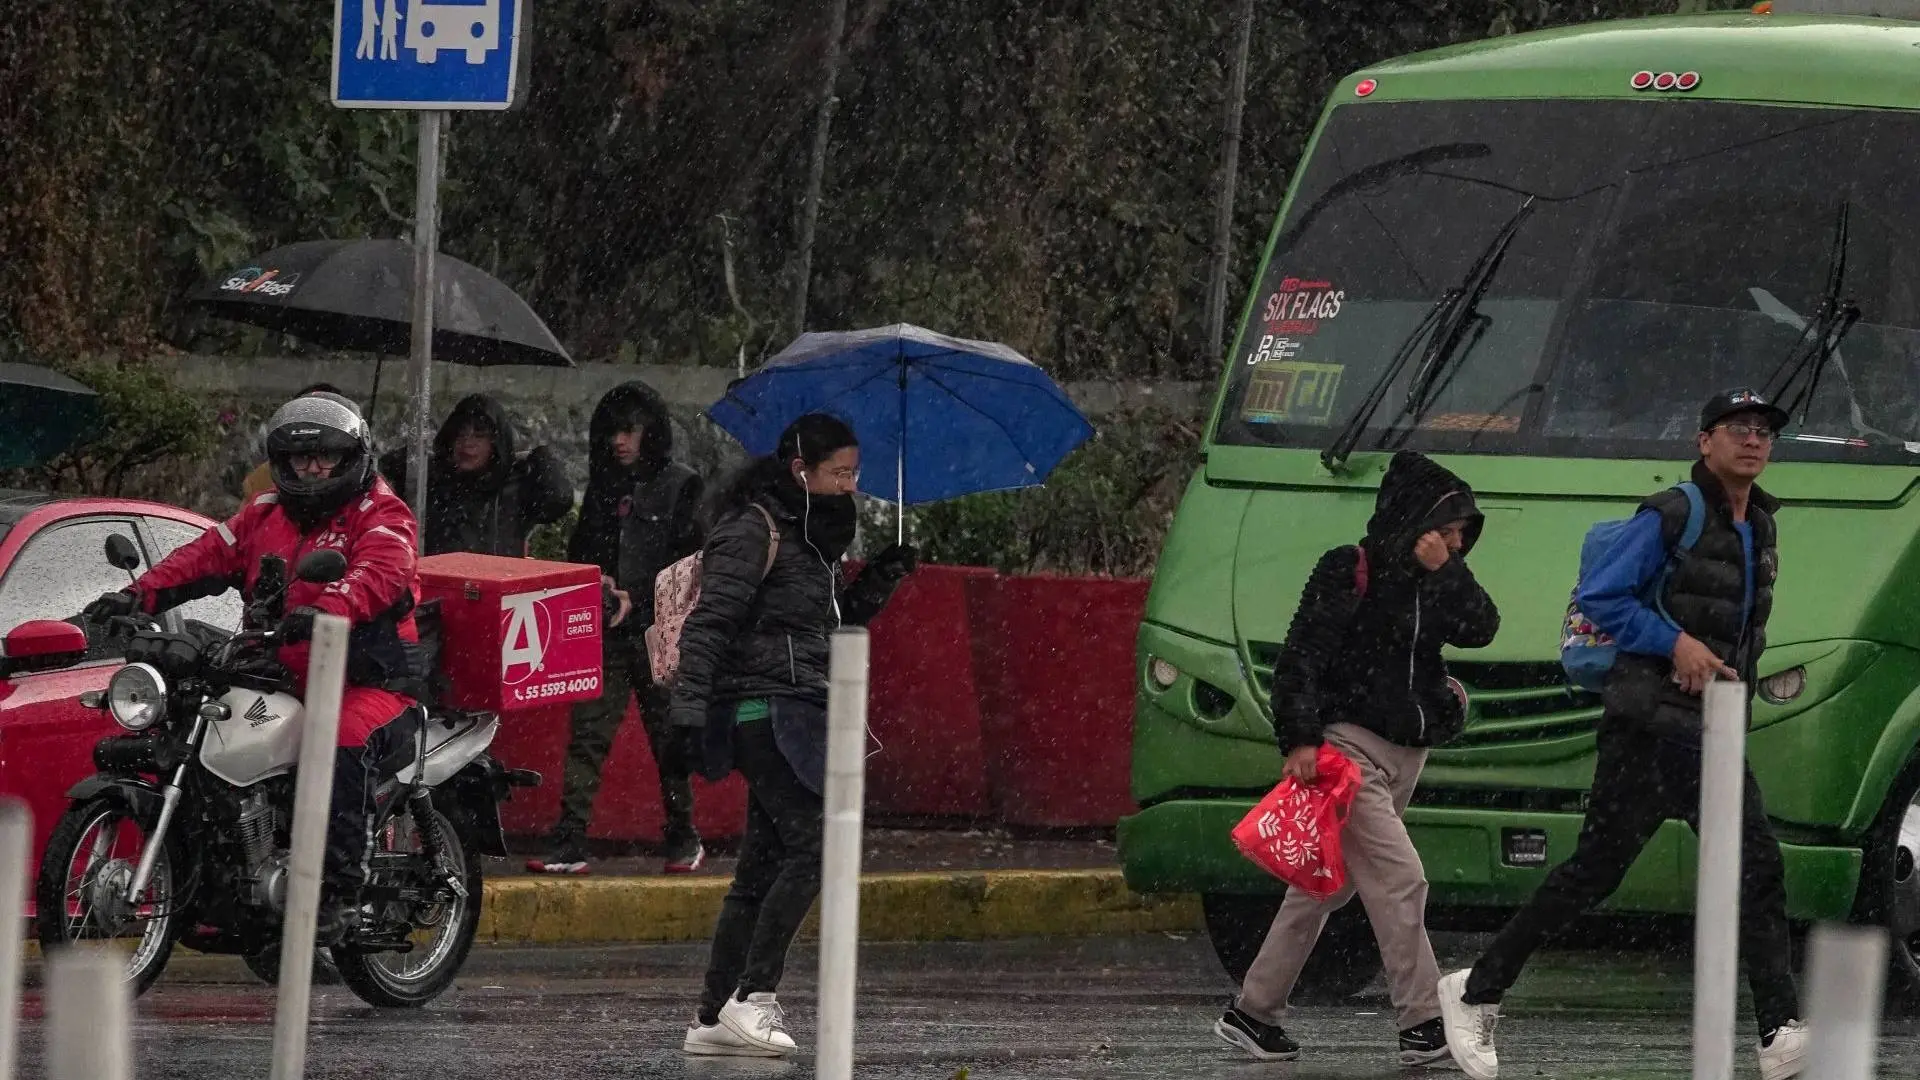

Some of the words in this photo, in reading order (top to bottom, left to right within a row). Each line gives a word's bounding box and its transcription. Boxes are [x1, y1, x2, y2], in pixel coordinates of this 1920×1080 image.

[253, 280, 295, 296] Flags
[1263, 292, 1293, 322] SIX
[1289, 290, 1345, 320] FLAGS
[568, 610, 592, 623] ENVÍO
[567, 623, 593, 636] GRATIS
[525, 685, 539, 700] 55
[540, 681, 567, 698] 5593
[567, 676, 598, 693] 4000
[250, 713, 281, 728] HONDA
